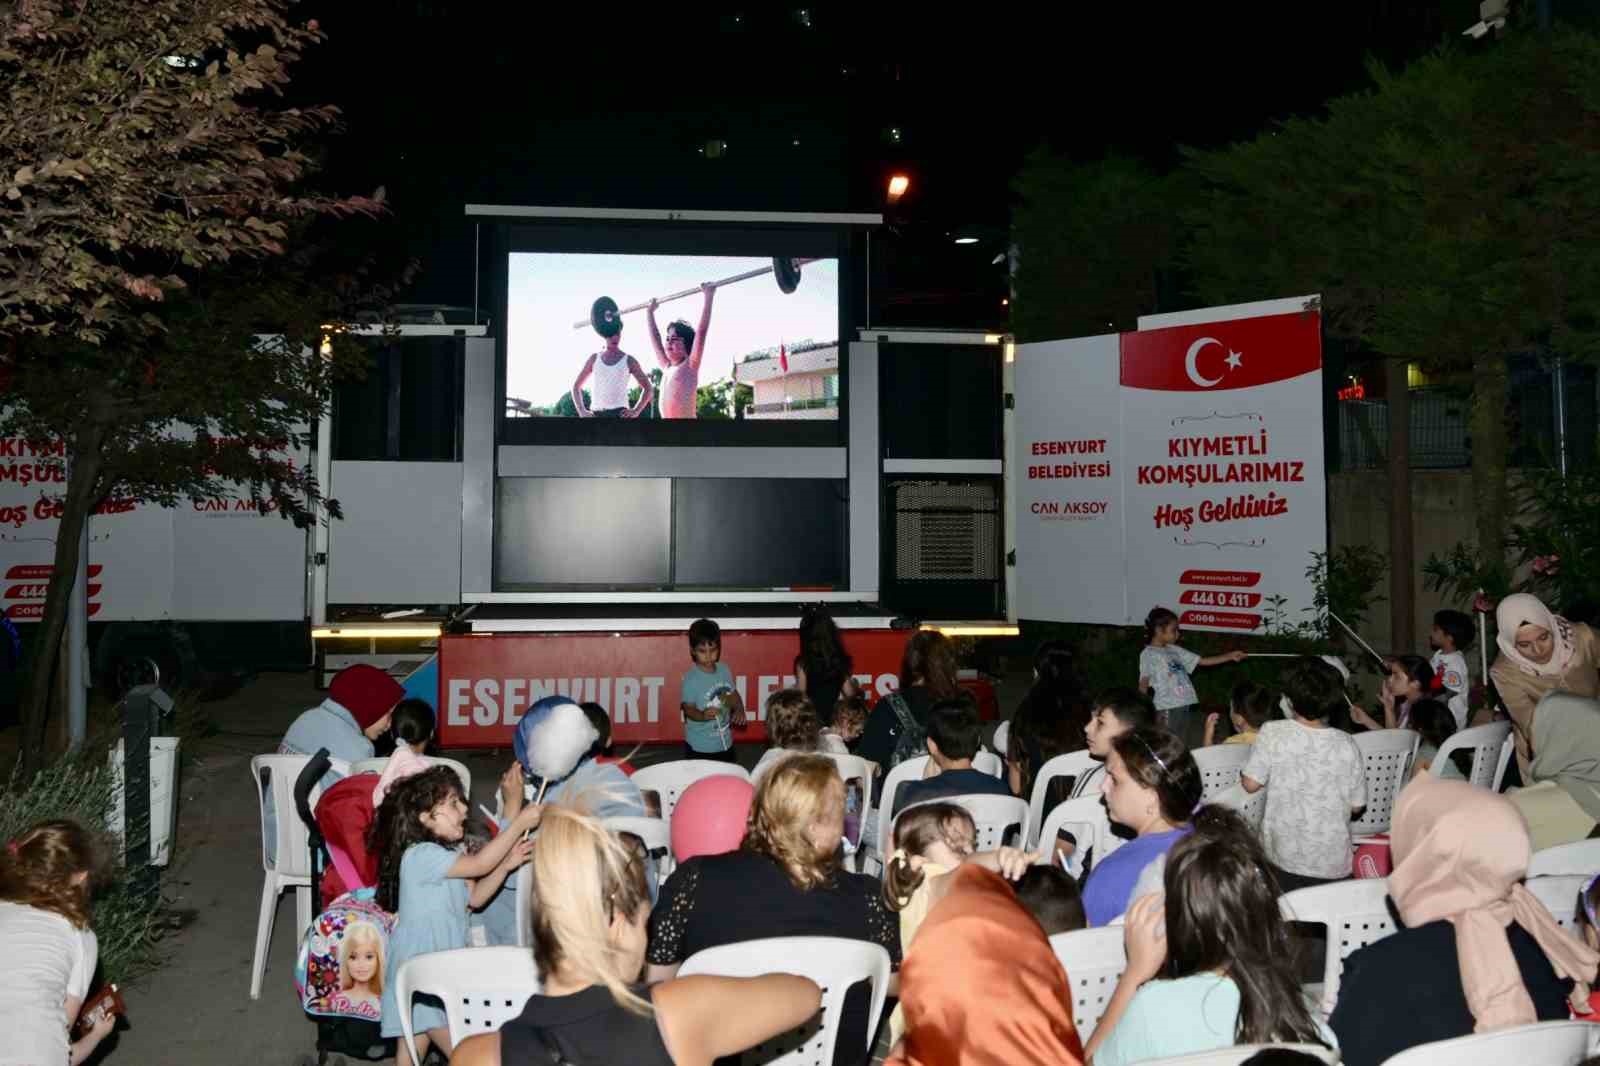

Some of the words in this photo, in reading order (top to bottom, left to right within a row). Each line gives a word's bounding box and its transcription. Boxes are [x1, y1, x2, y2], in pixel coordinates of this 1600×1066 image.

[1031, 439, 1107, 456] ESENYURT
[1168, 428, 1267, 458] KIYMETLİ
[1028, 460, 1111, 480] BELEDİYESİ
[1137, 461, 1305, 488] KOMŞULARIMIZ
[193, 499, 229, 512] CAN
[1031, 502, 1059, 515] CAN
[1063, 502, 1109, 515] AKSOY
[1153, 503, 1195, 531] Hoş
[1198, 491, 1289, 523] Geldiniz
[1191, 591, 1216, 605] 444
[1217, 592, 1227, 606] 0
[1229, 592, 1250, 607] 411
